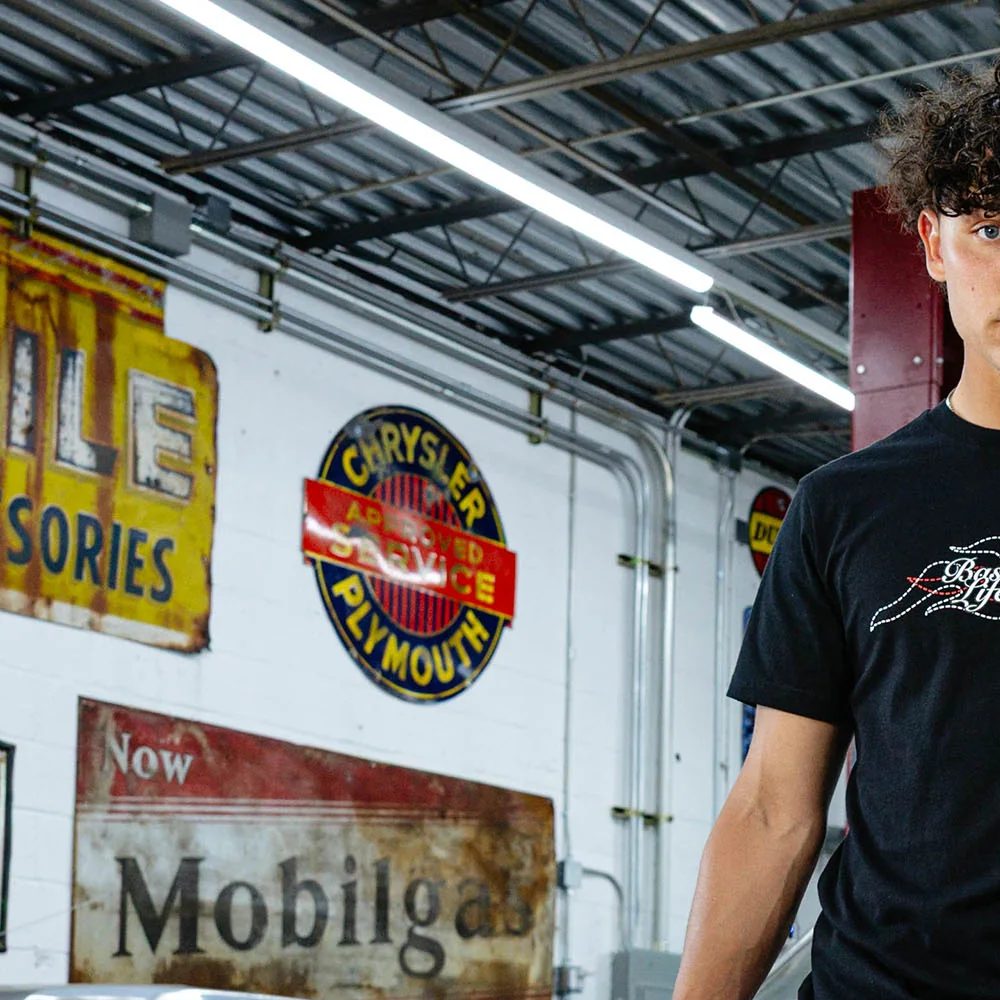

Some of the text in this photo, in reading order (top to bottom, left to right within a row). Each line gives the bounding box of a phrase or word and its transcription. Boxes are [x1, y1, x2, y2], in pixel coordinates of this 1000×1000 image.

[341, 422, 486, 527] CHRYSLER
[5, 496, 176, 604] SORIES
[330, 522, 496, 604] SERVICE
[346, 501, 484, 565] APPROVED
[332, 574, 490, 686] PLYMOUTH
[112, 854, 536, 979] Mobilgas
